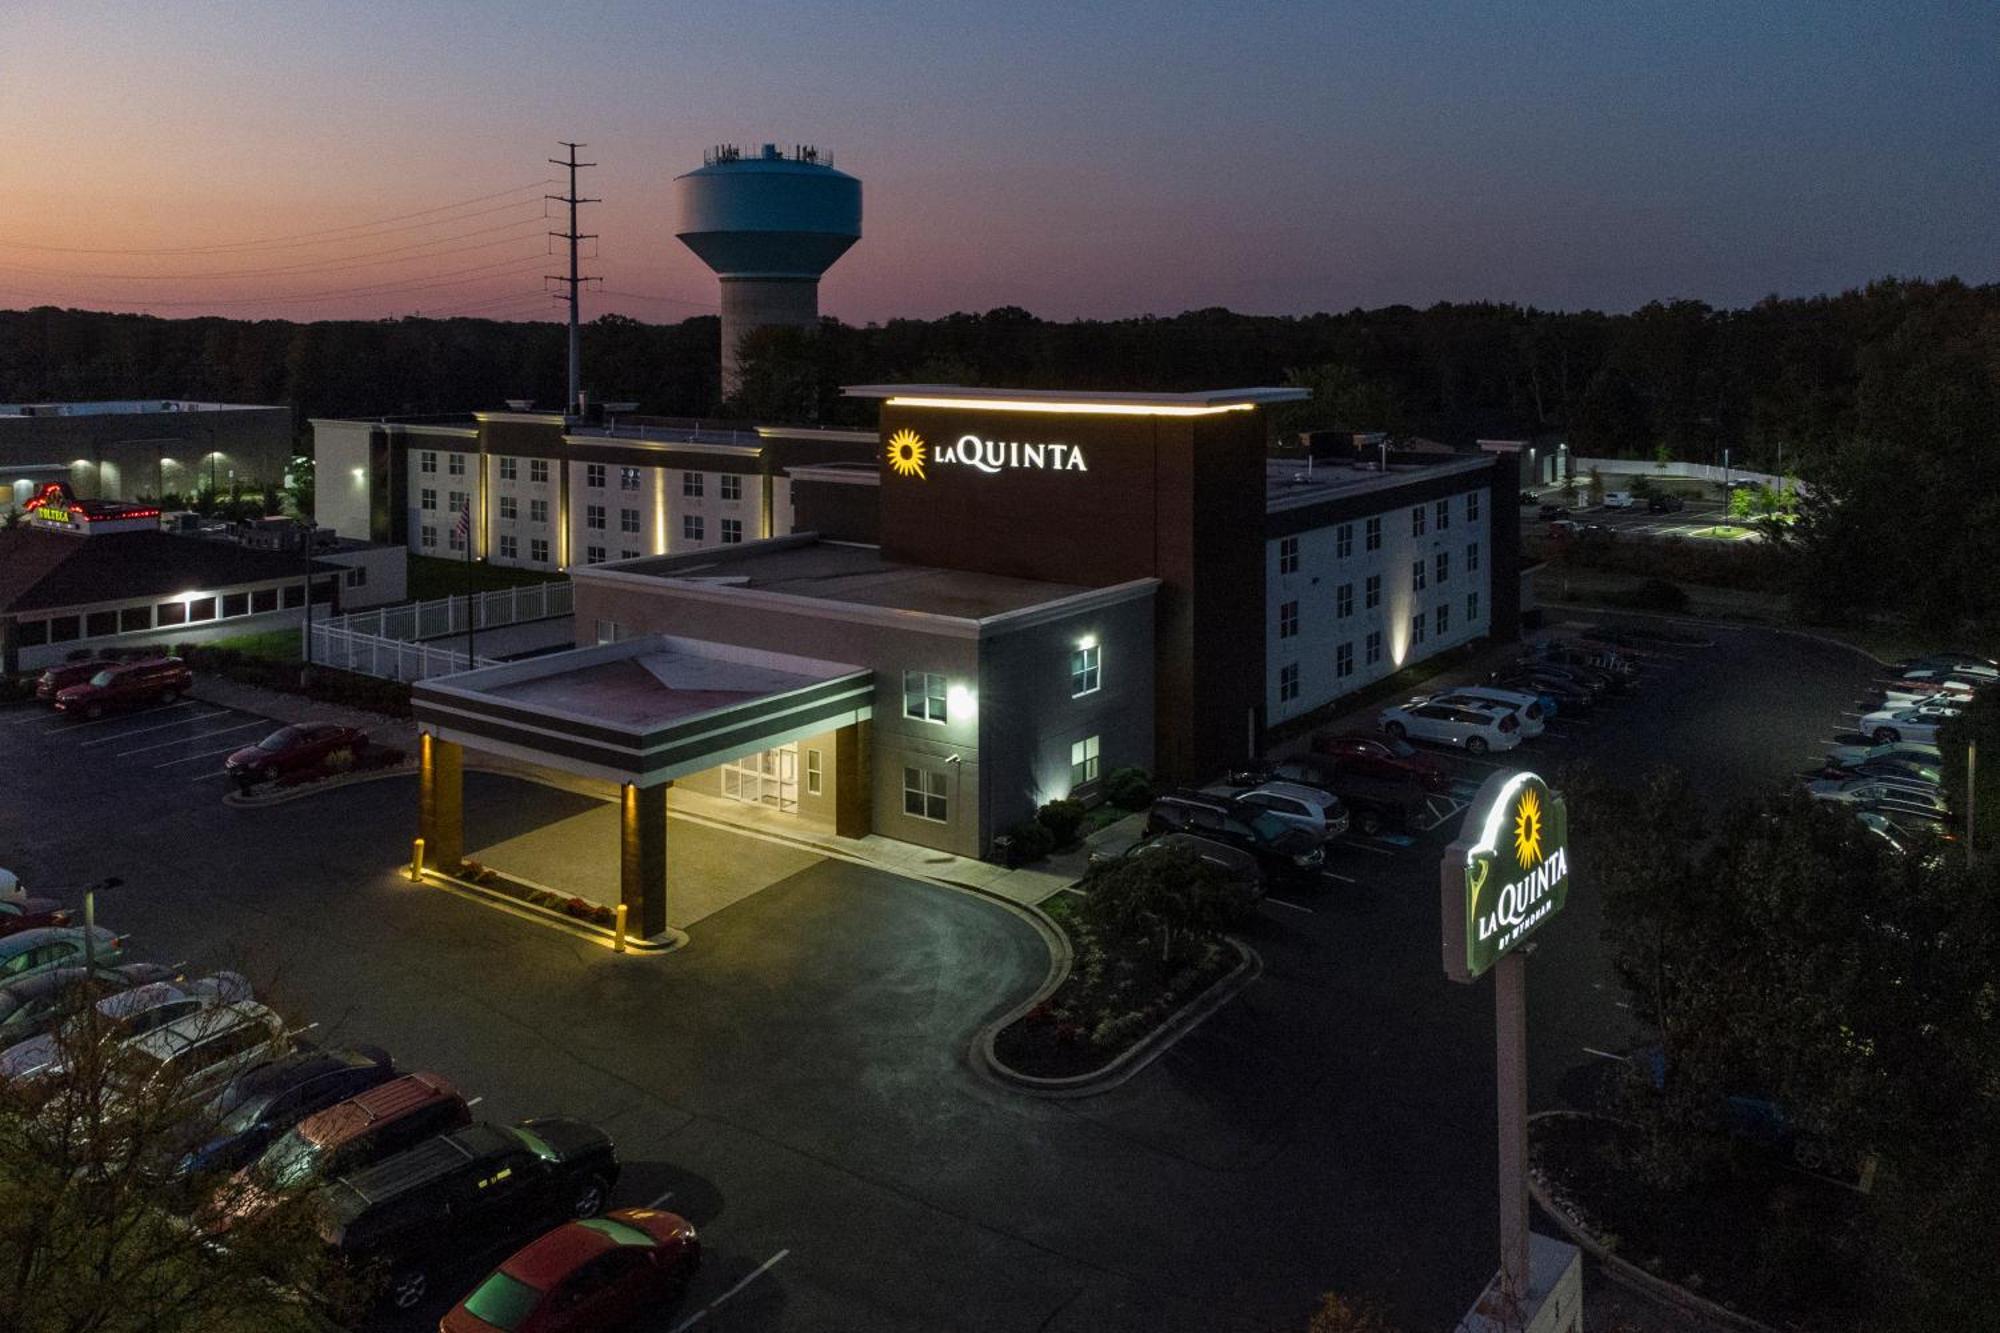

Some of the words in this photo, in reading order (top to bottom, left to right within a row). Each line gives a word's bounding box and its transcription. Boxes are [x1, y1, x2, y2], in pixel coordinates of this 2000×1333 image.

[934, 446, 957, 463] LA
[957, 435, 1088, 473] QUINTA
[1479, 911, 1498, 941] LA
[1498, 846, 1567, 925] QUINTA
